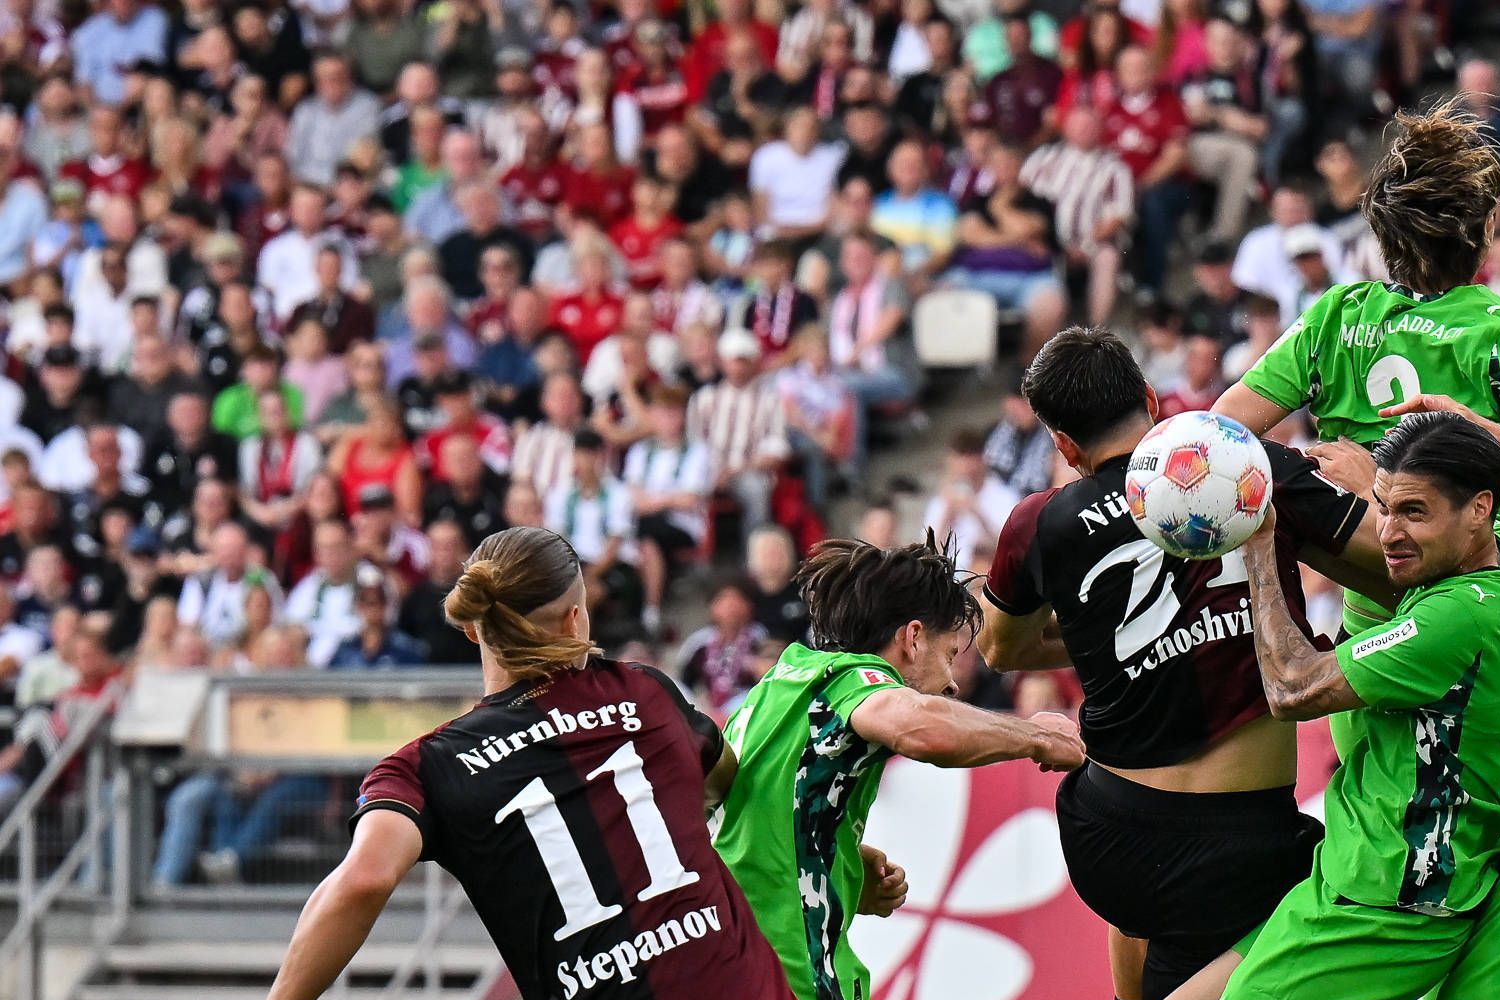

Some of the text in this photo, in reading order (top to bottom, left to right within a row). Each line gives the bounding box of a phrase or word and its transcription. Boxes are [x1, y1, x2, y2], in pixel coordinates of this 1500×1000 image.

[1355, 630, 1400, 655] sonepar
[455, 701, 642, 776] Nürnberg
[495, 740, 700, 942] 11
[556, 905, 722, 1000] Stepanov
